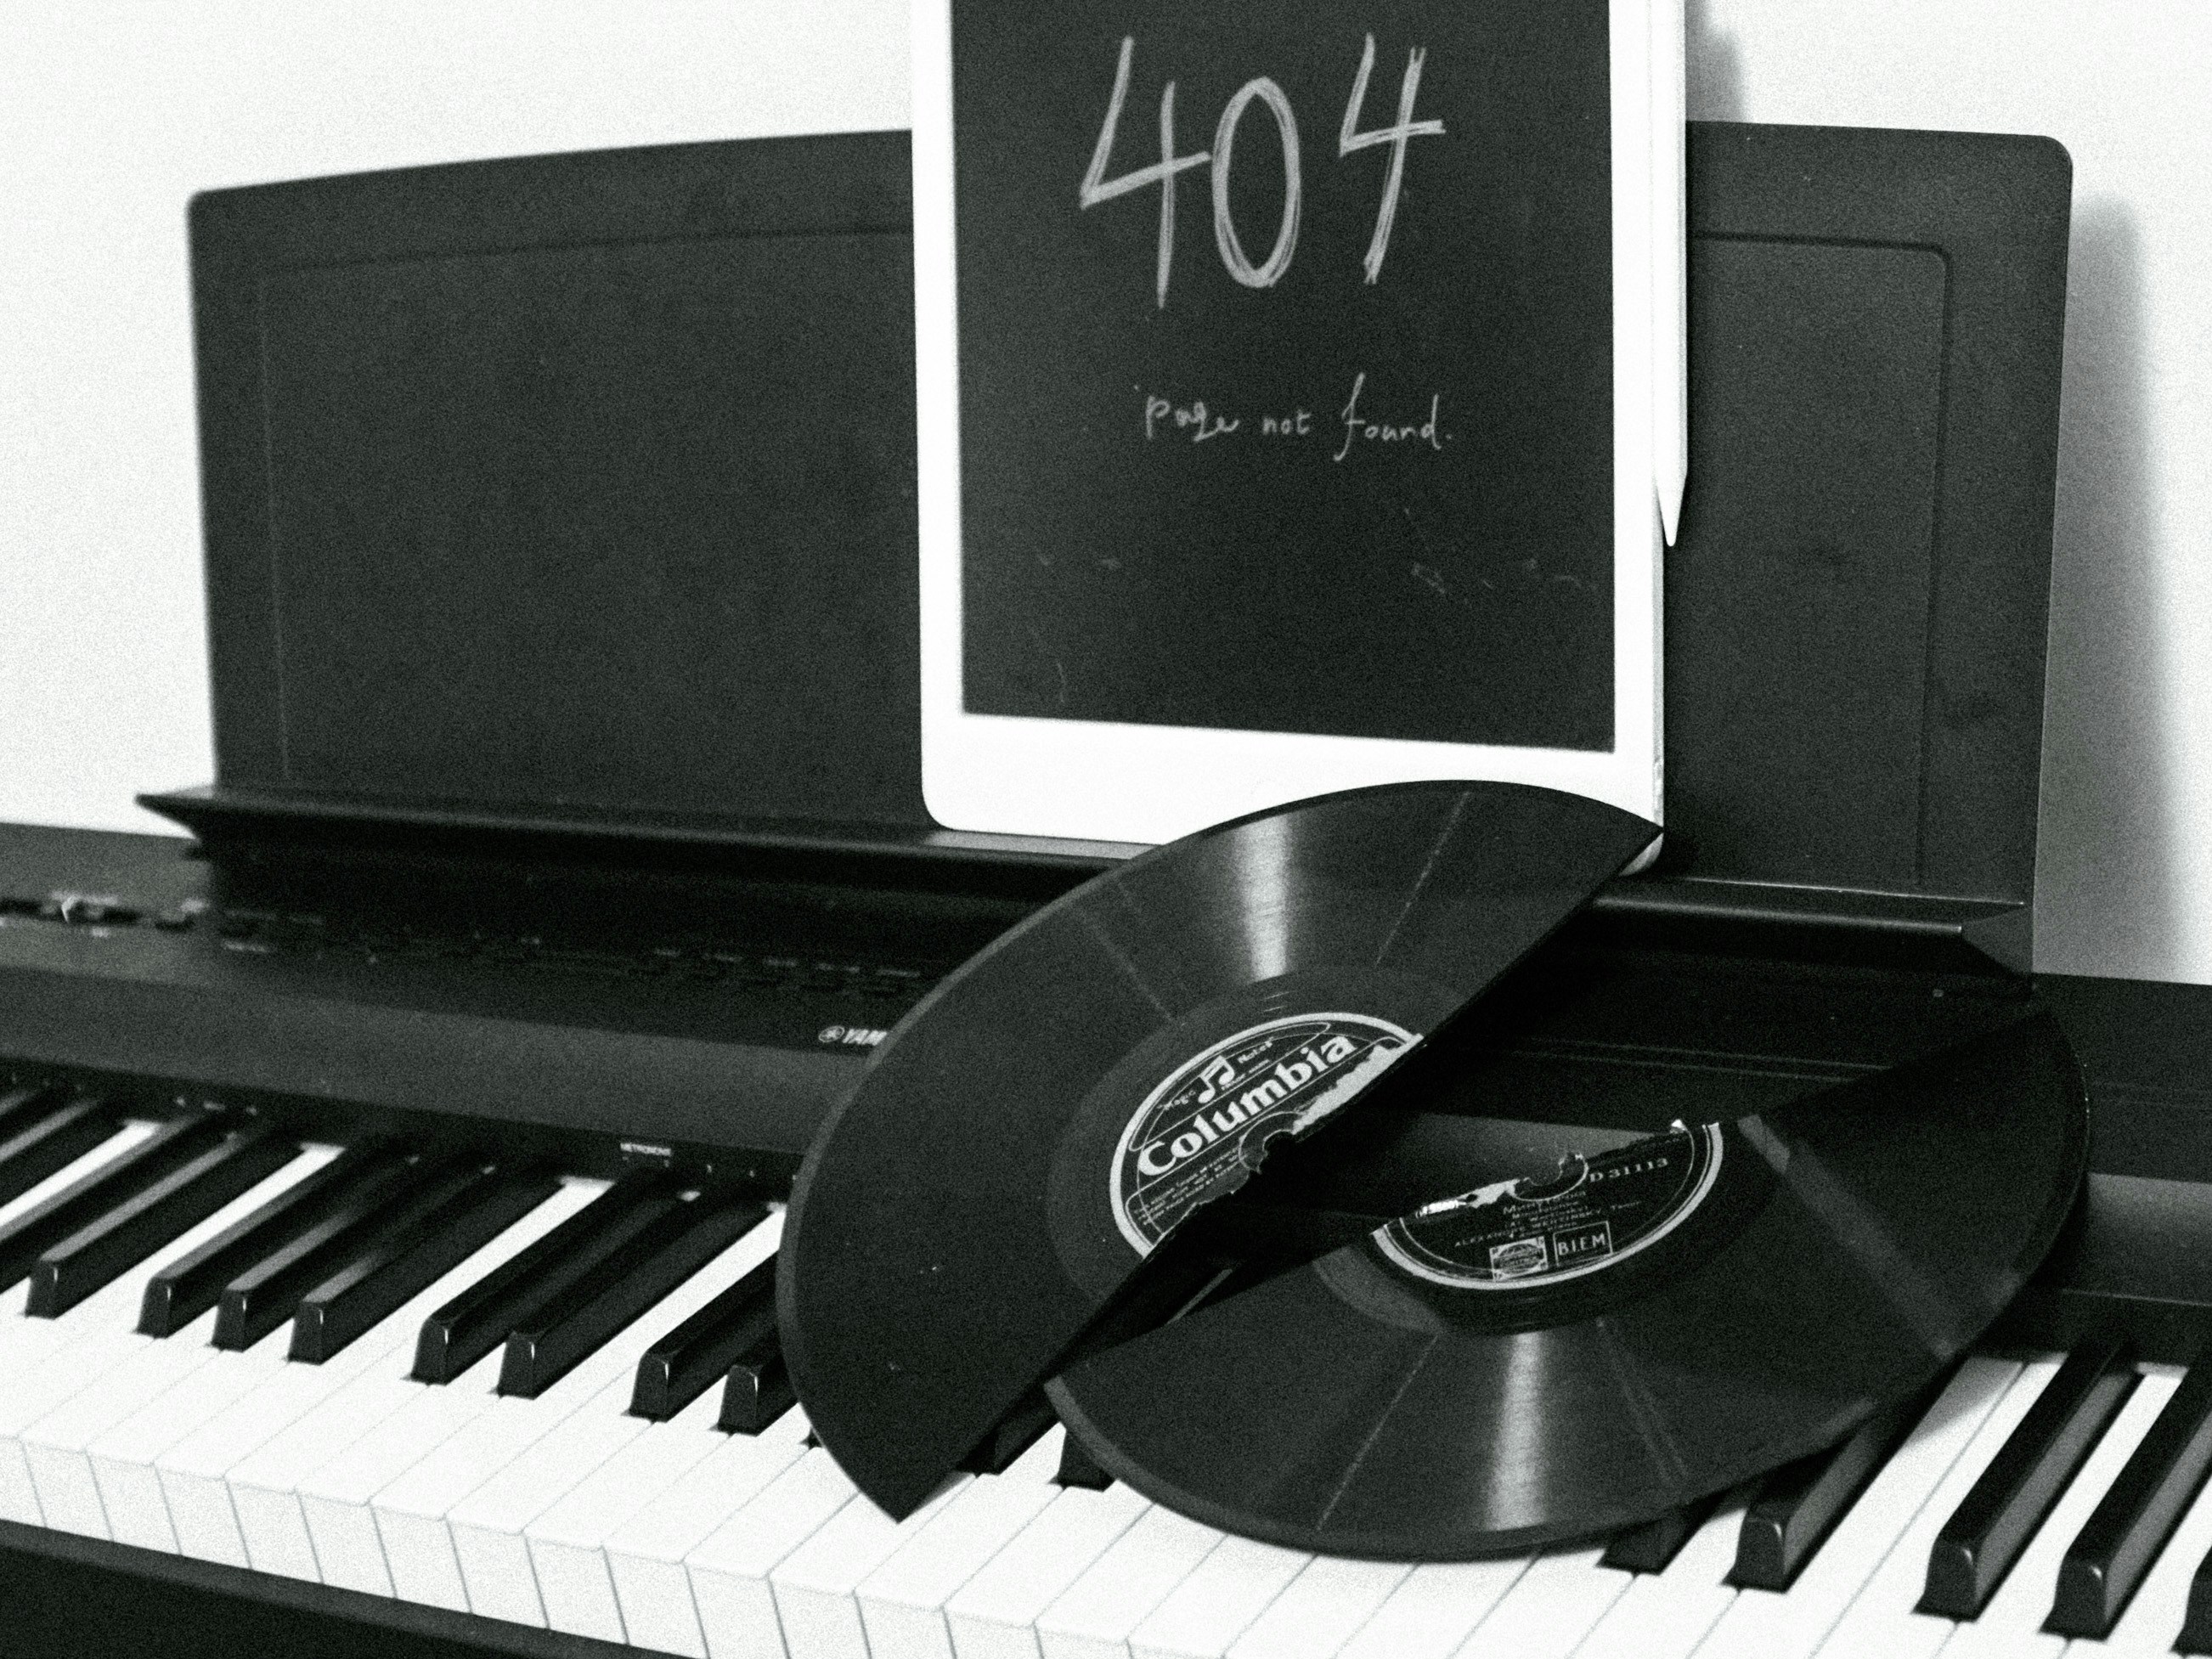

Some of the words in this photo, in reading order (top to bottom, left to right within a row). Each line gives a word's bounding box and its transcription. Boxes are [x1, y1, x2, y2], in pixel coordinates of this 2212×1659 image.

[1080, 32, 1446, 309] 404
[1146, 395, 1239, 443] page
[1263, 408, 1312, 436] not
[842, 1028, 888, 1047] YAM
[1137, 1035, 1357, 1177] Columbia
